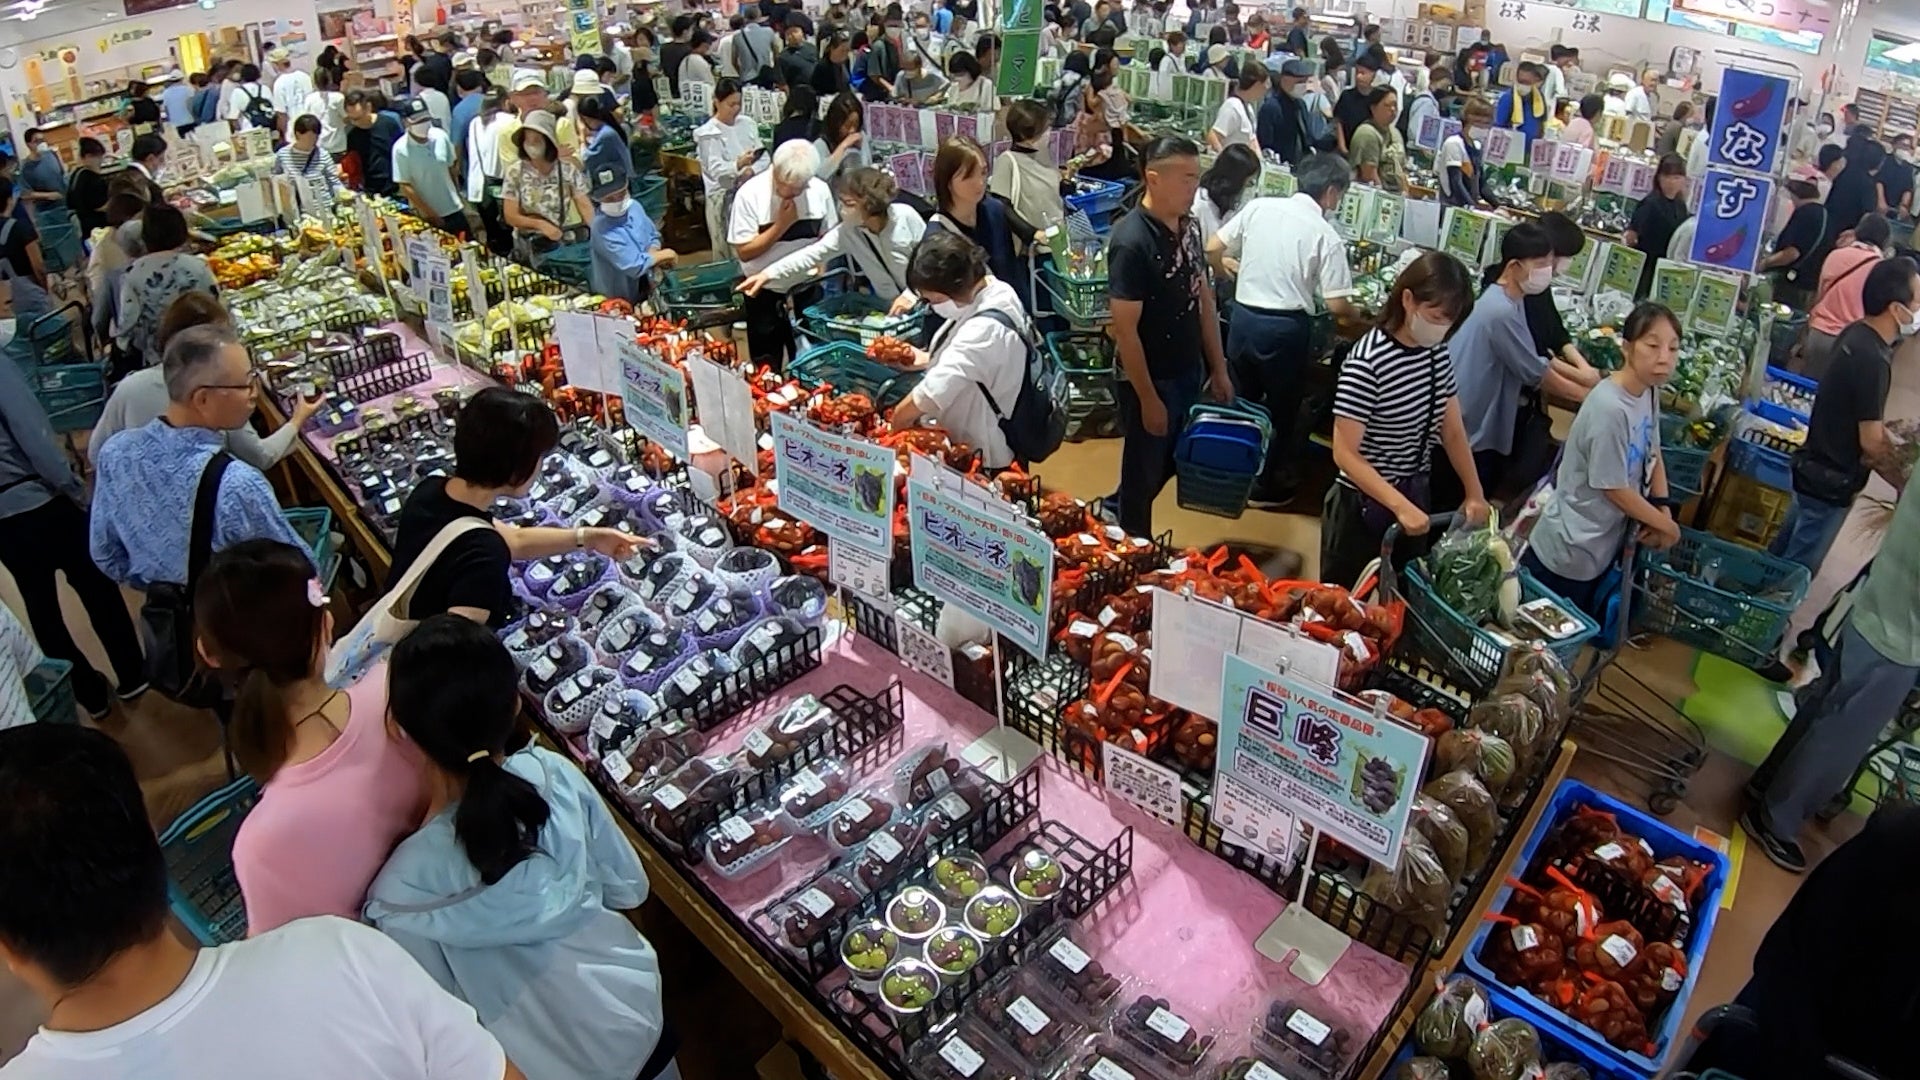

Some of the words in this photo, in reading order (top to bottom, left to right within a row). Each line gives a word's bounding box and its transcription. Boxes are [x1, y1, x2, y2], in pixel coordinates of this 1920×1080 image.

[1499, 1, 1527, 21] お米
[1572, 13, 1601, 33] お米
[1716, 121, 1768, 220] なす
[783, 438, 854, 488] ピオーネ
[921, 506, 1009, 572] ピオーネ
[1243, 686, 1344, 768] 巨峰
